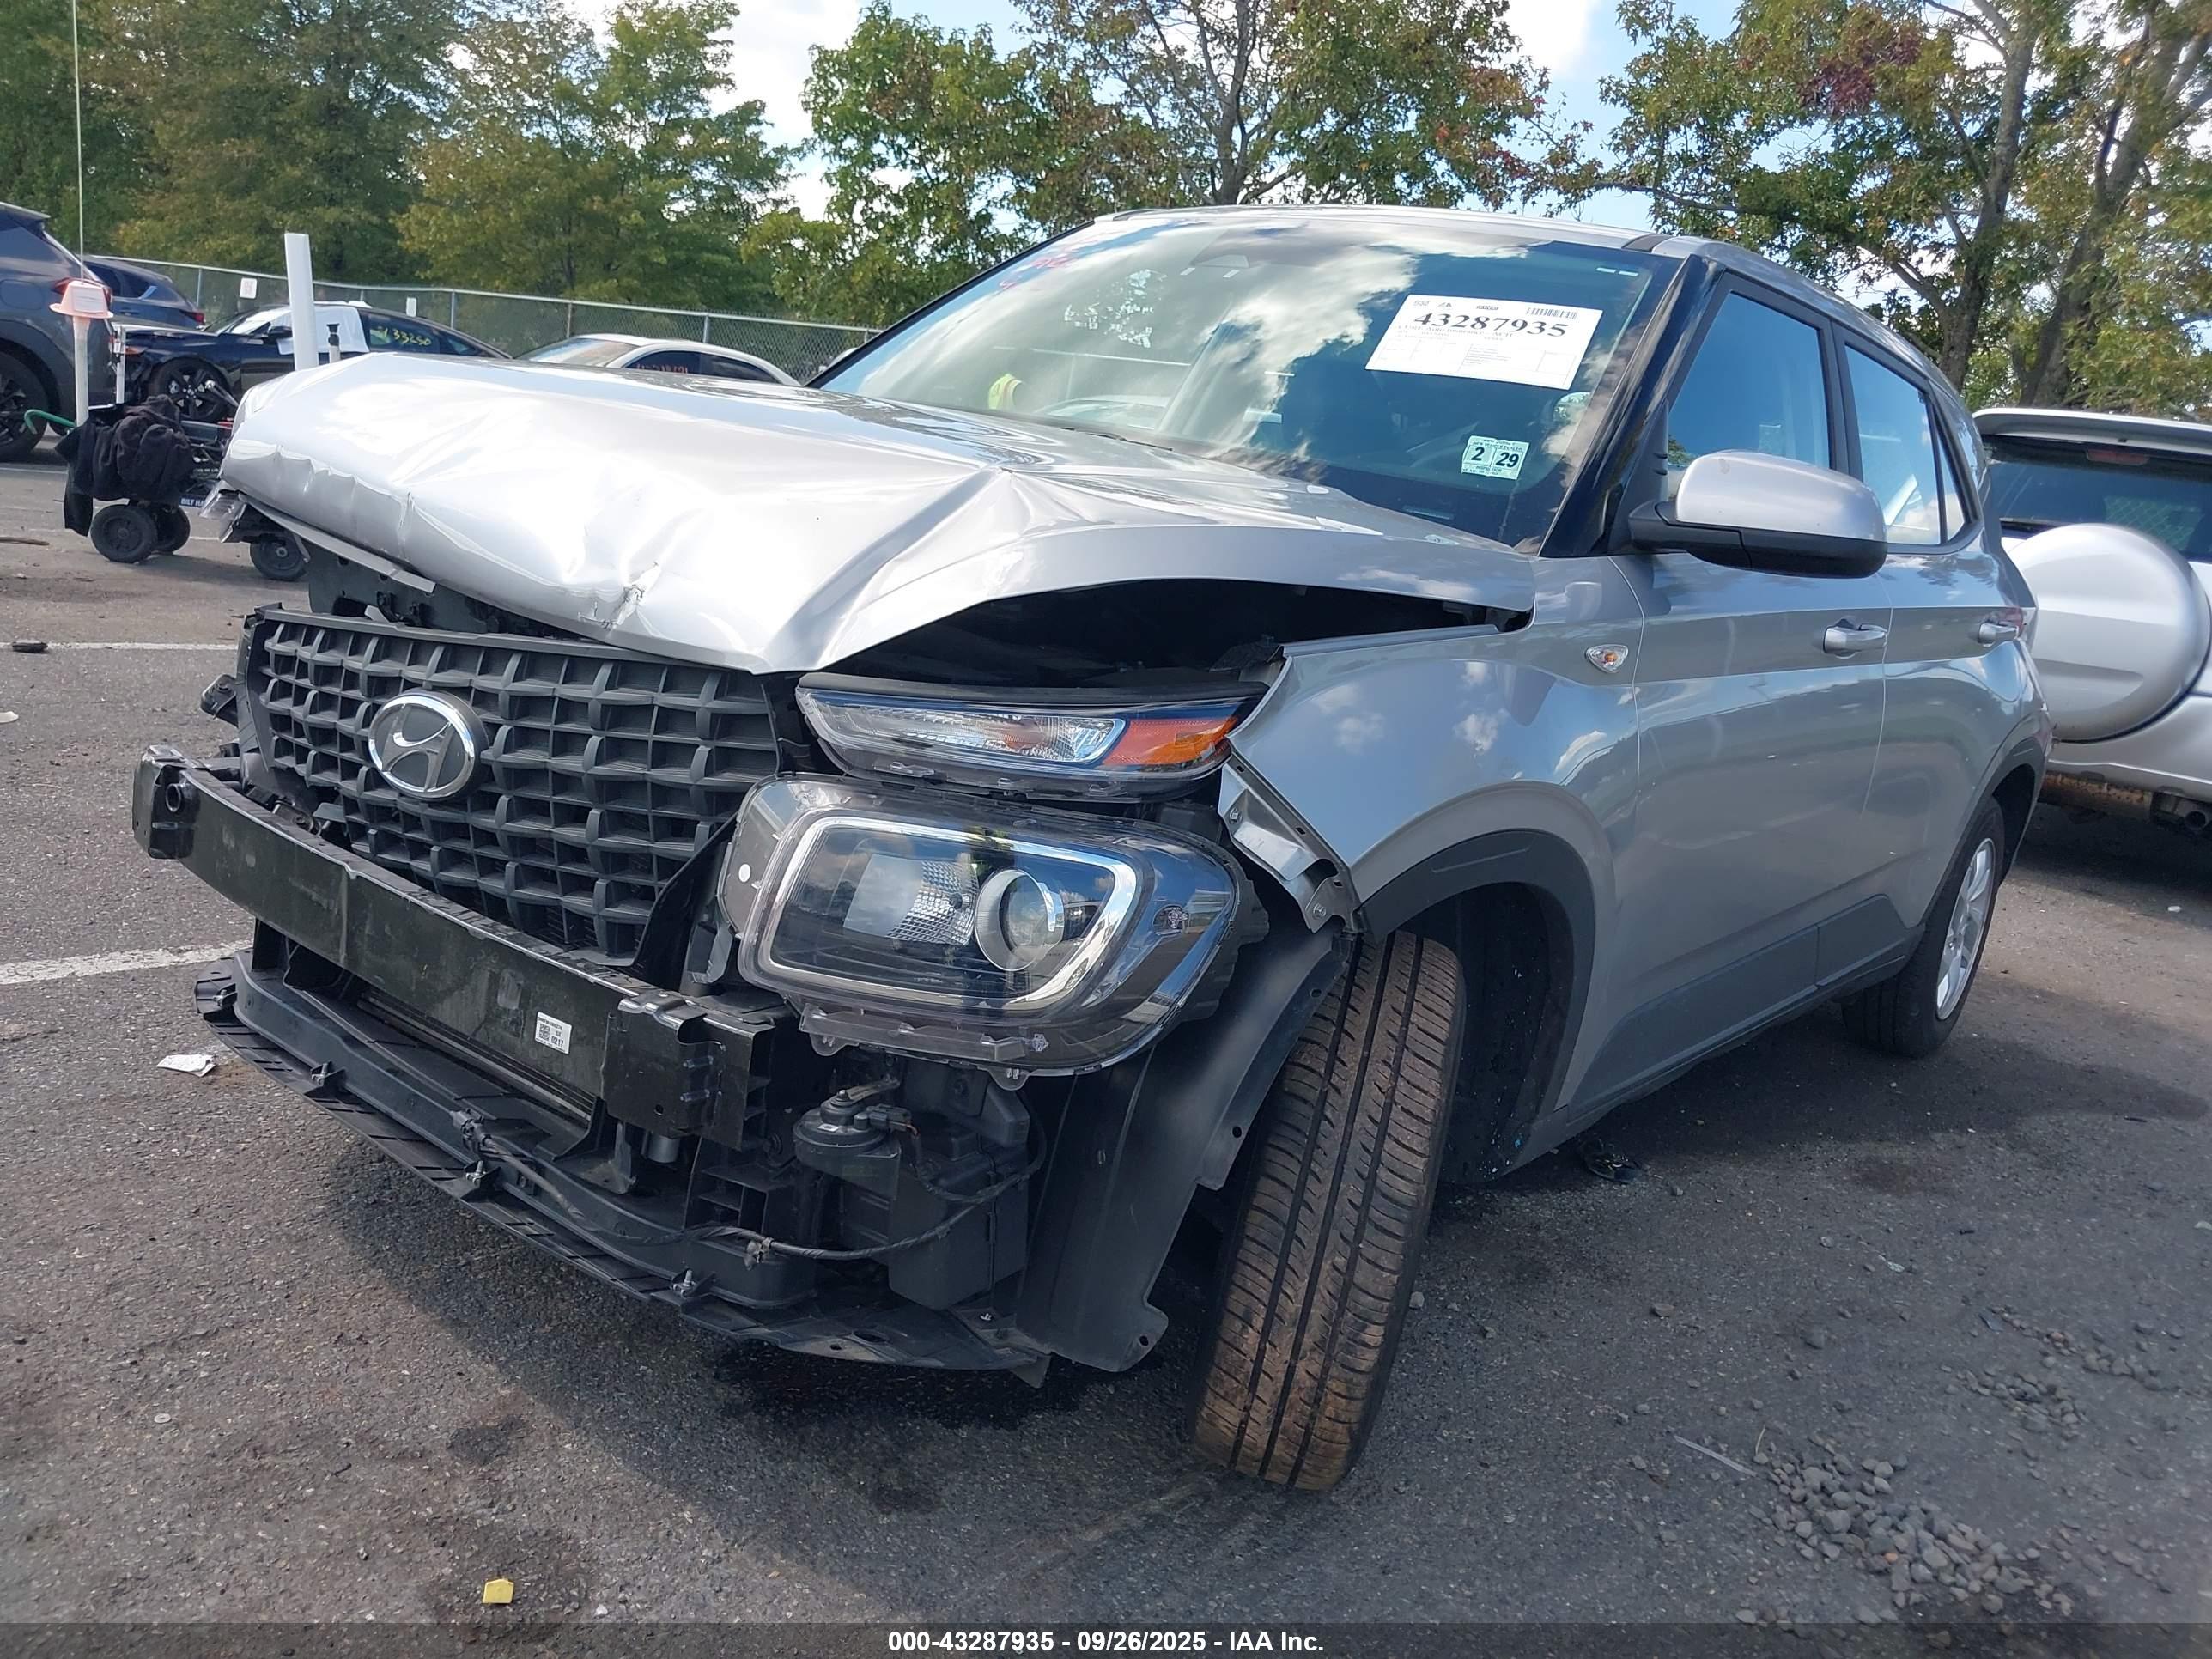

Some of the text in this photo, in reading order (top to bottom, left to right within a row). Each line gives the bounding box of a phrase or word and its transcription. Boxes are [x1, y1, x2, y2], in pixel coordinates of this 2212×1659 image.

[1414, 312, 1570, 337] 43287935
[1471, 447, 1519, 468] 2 29
